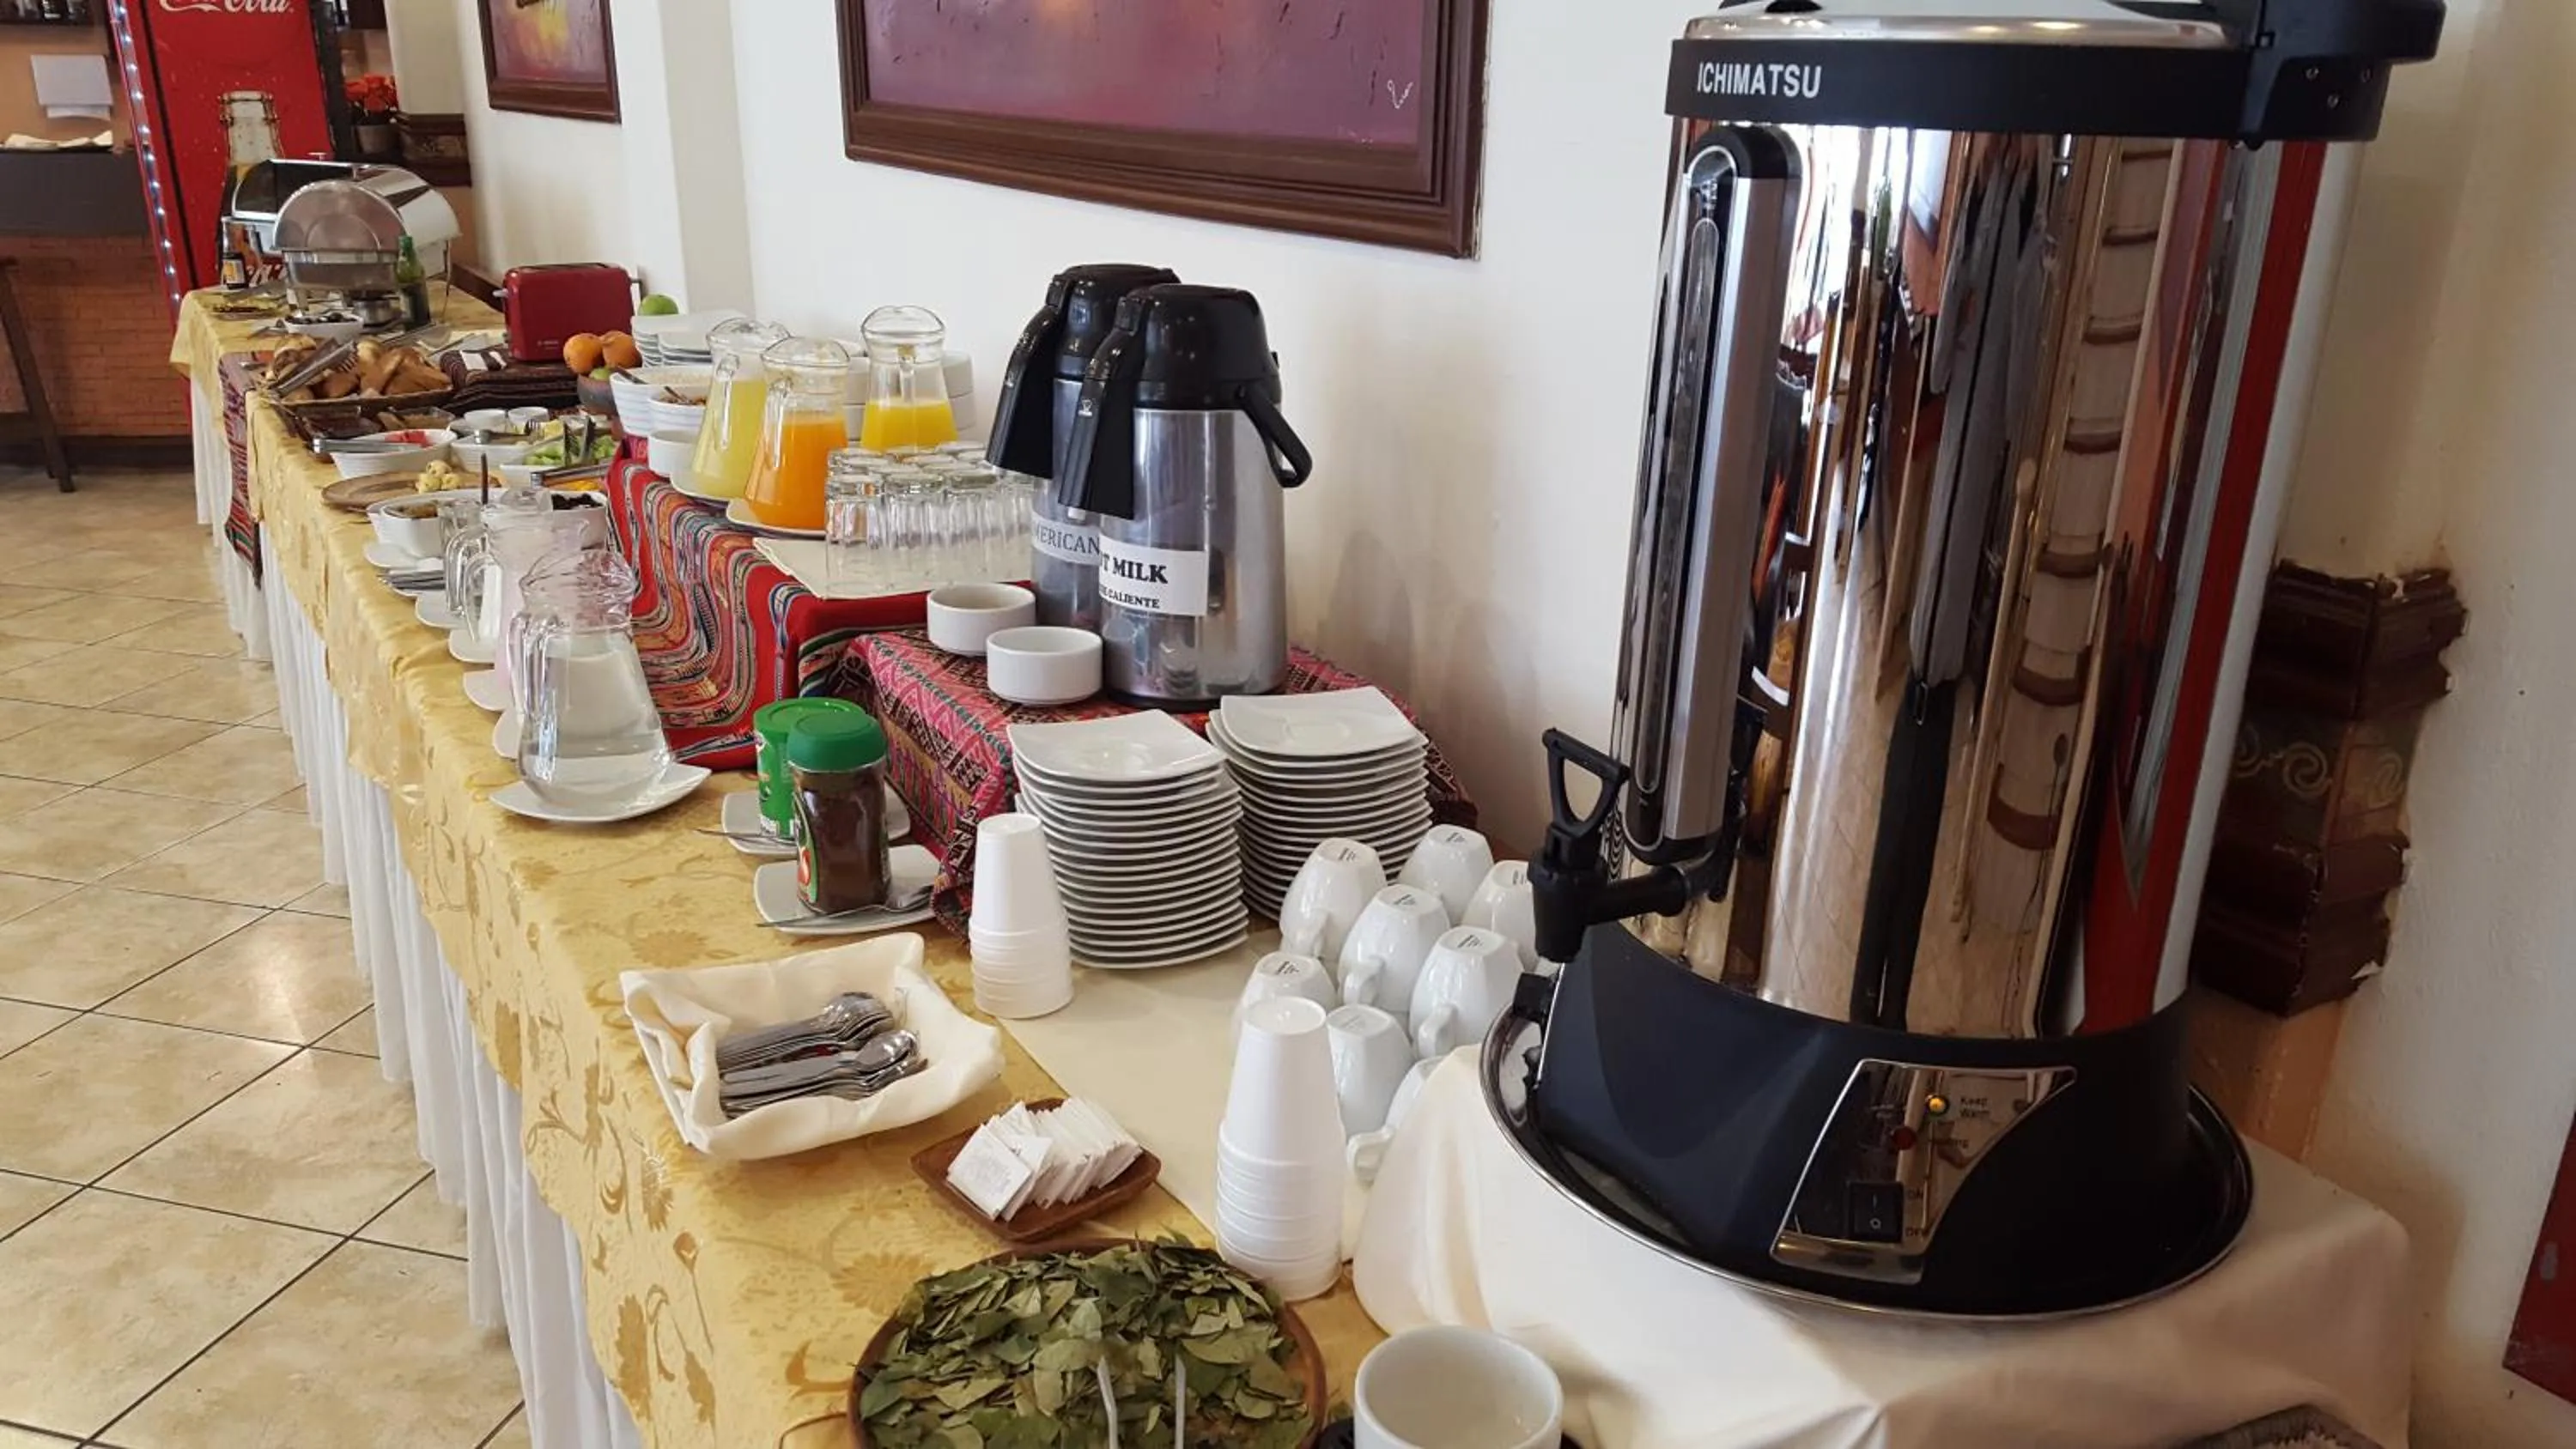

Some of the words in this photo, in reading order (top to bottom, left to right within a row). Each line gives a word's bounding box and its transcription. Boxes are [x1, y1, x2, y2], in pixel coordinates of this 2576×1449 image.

[1697, 61, 1822, 99] ICHIMATSU
[1113, 556, 1168, 584] MILK
[1109, 588, 1160, 609] CALIENTE
